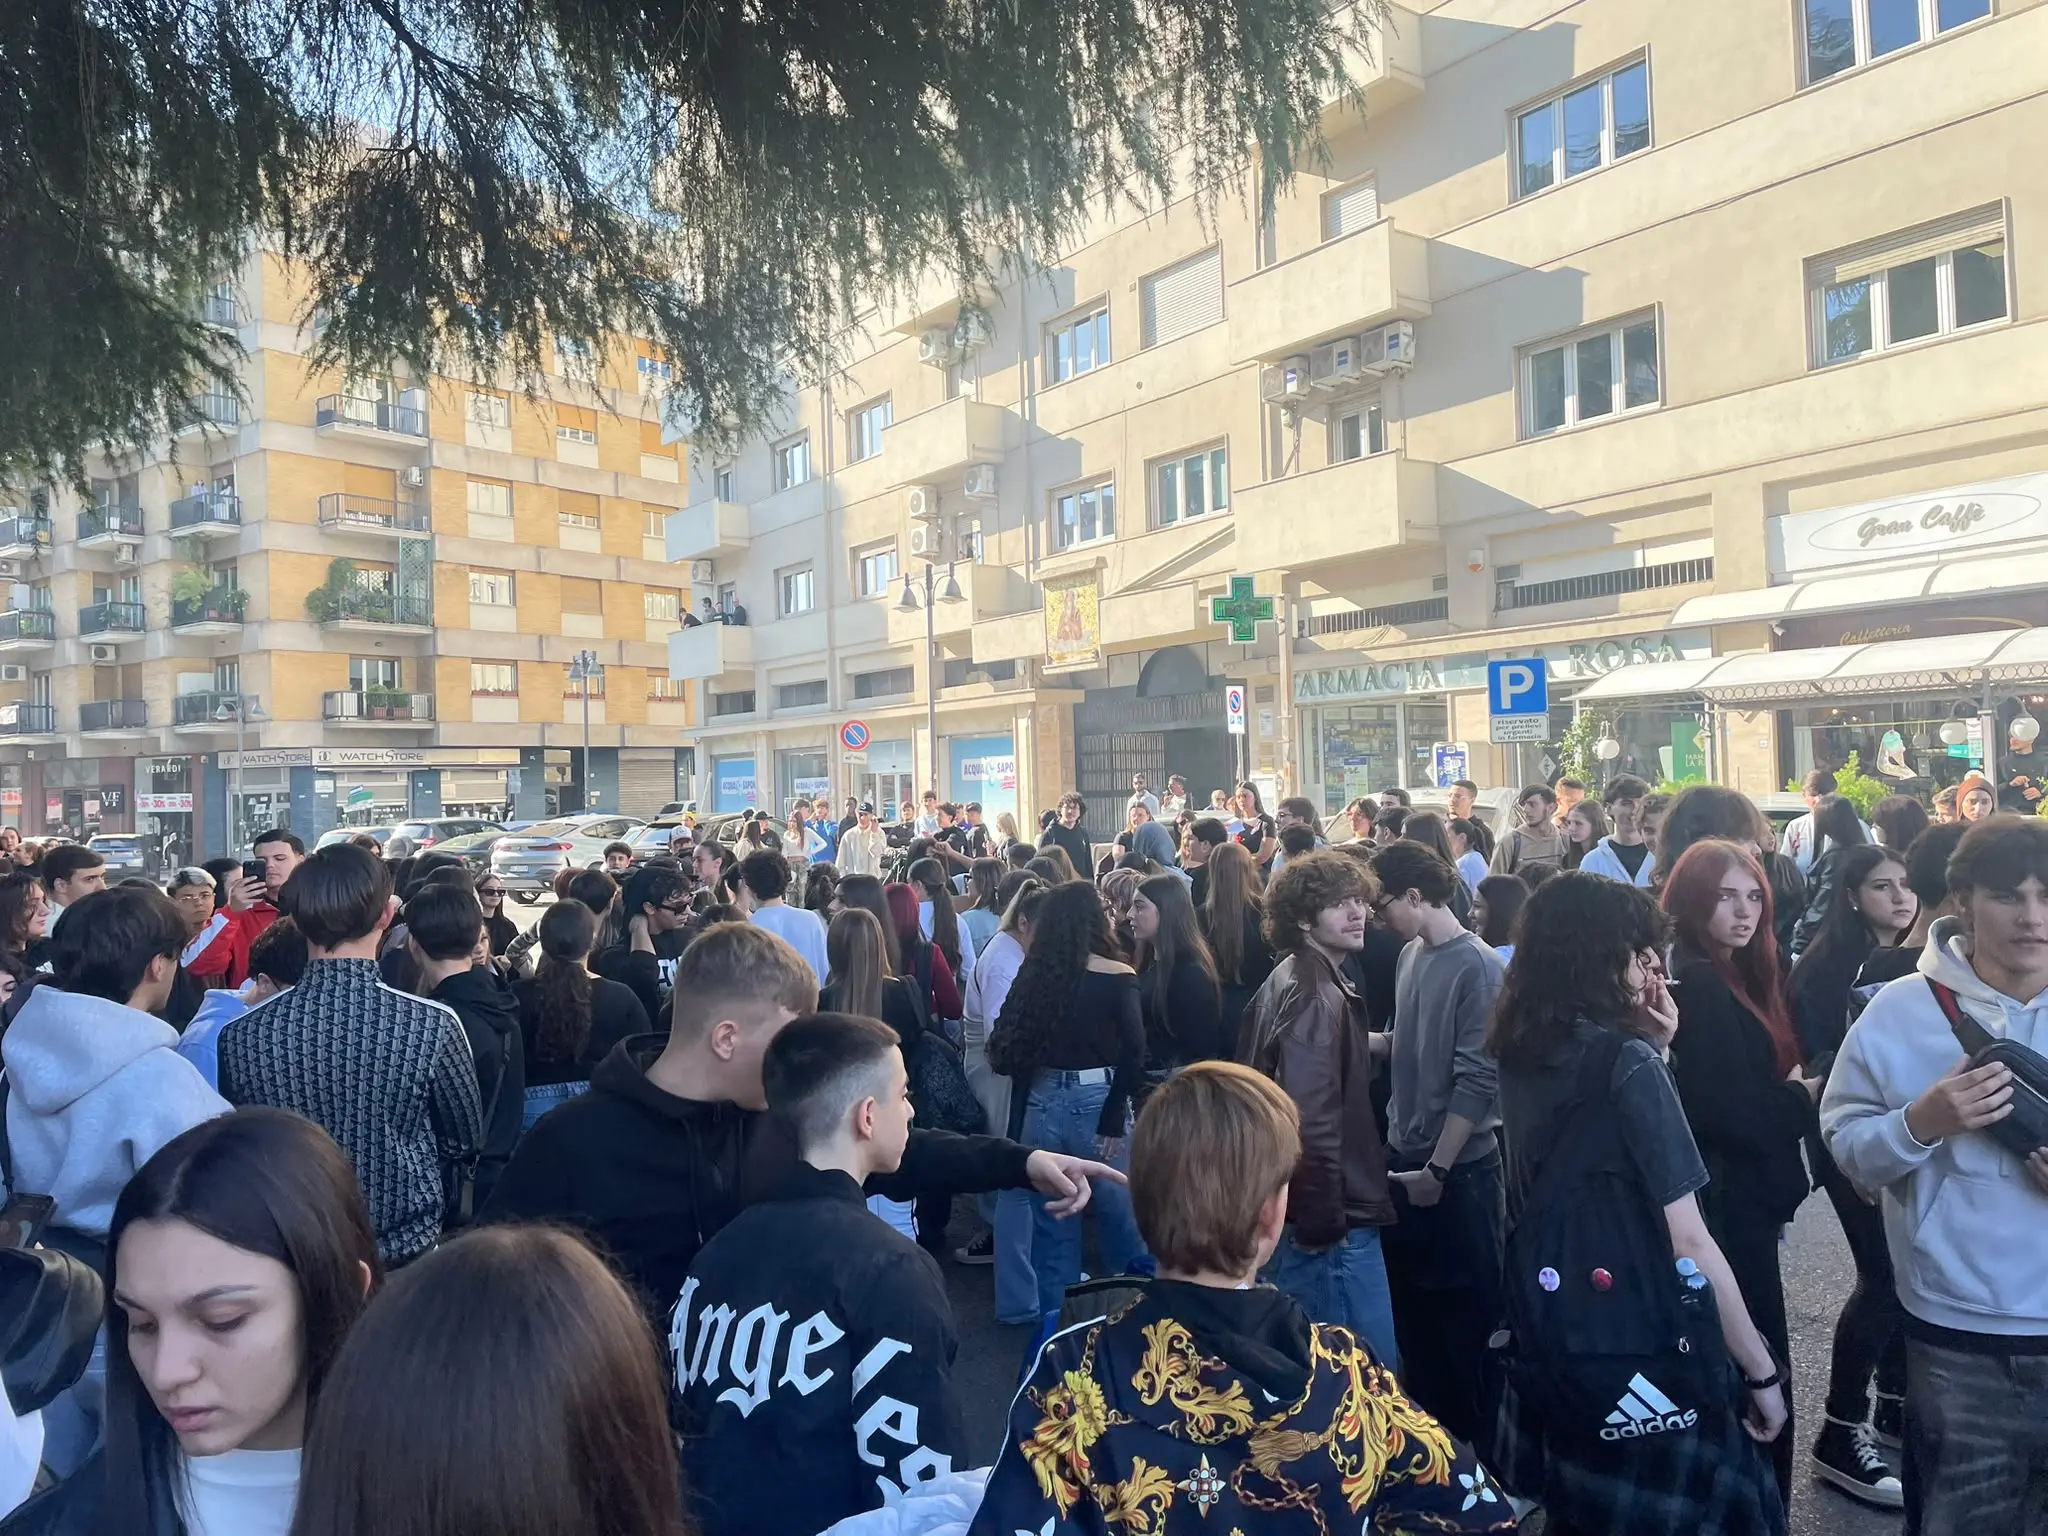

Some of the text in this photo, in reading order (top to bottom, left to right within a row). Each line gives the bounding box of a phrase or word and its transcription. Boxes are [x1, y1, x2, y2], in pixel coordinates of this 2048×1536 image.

[1857, 501, 1986, 548] Gran Caffè
[1840, 622, 1912, 645] Caffetteria
[1500, 665, 1535, 709] P
[1503, 728, 1533, 736] urgenti
[964, 763, 985, 776] ACQUA
[101, 791, 121, 807] VF
[1600, 1408, 1698, 1441] adidas
